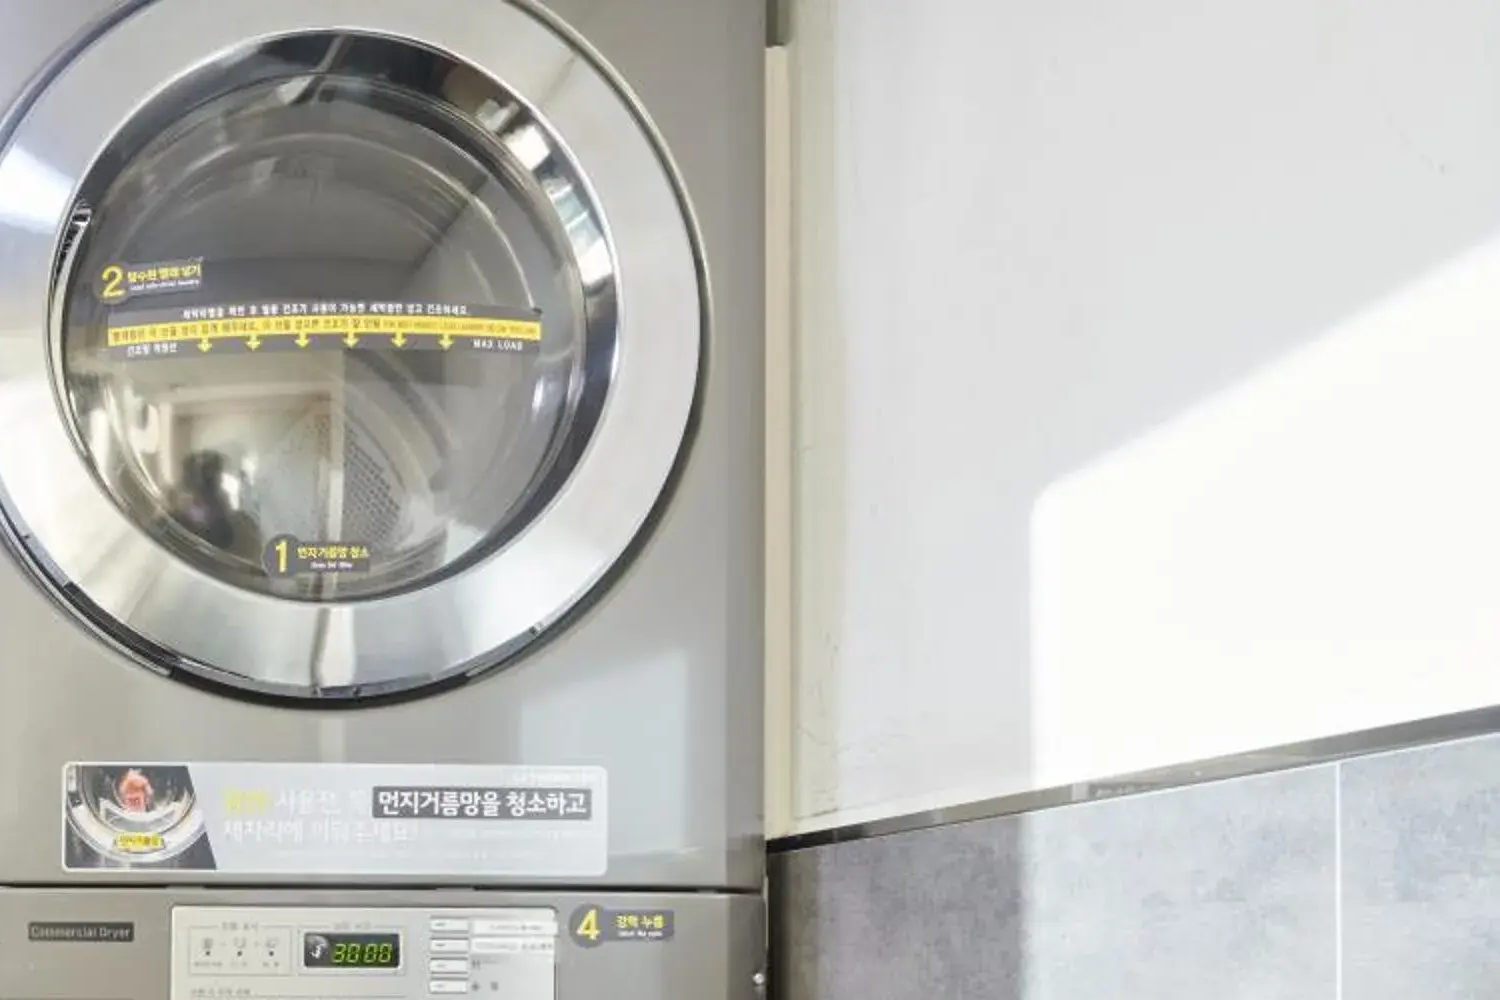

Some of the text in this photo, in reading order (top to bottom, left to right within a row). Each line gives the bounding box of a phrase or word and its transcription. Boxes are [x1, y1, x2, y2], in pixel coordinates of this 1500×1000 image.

[101, 265, 125, 298] 2
[275, 541, 287, 573] 1
[378, 789, 500, 817] 먼지거름망을
[505, 790, 587, 816] 청소하고
[31, 926, 131, 940] Commercial Dryer
[576, 909, 600, 941] 4
